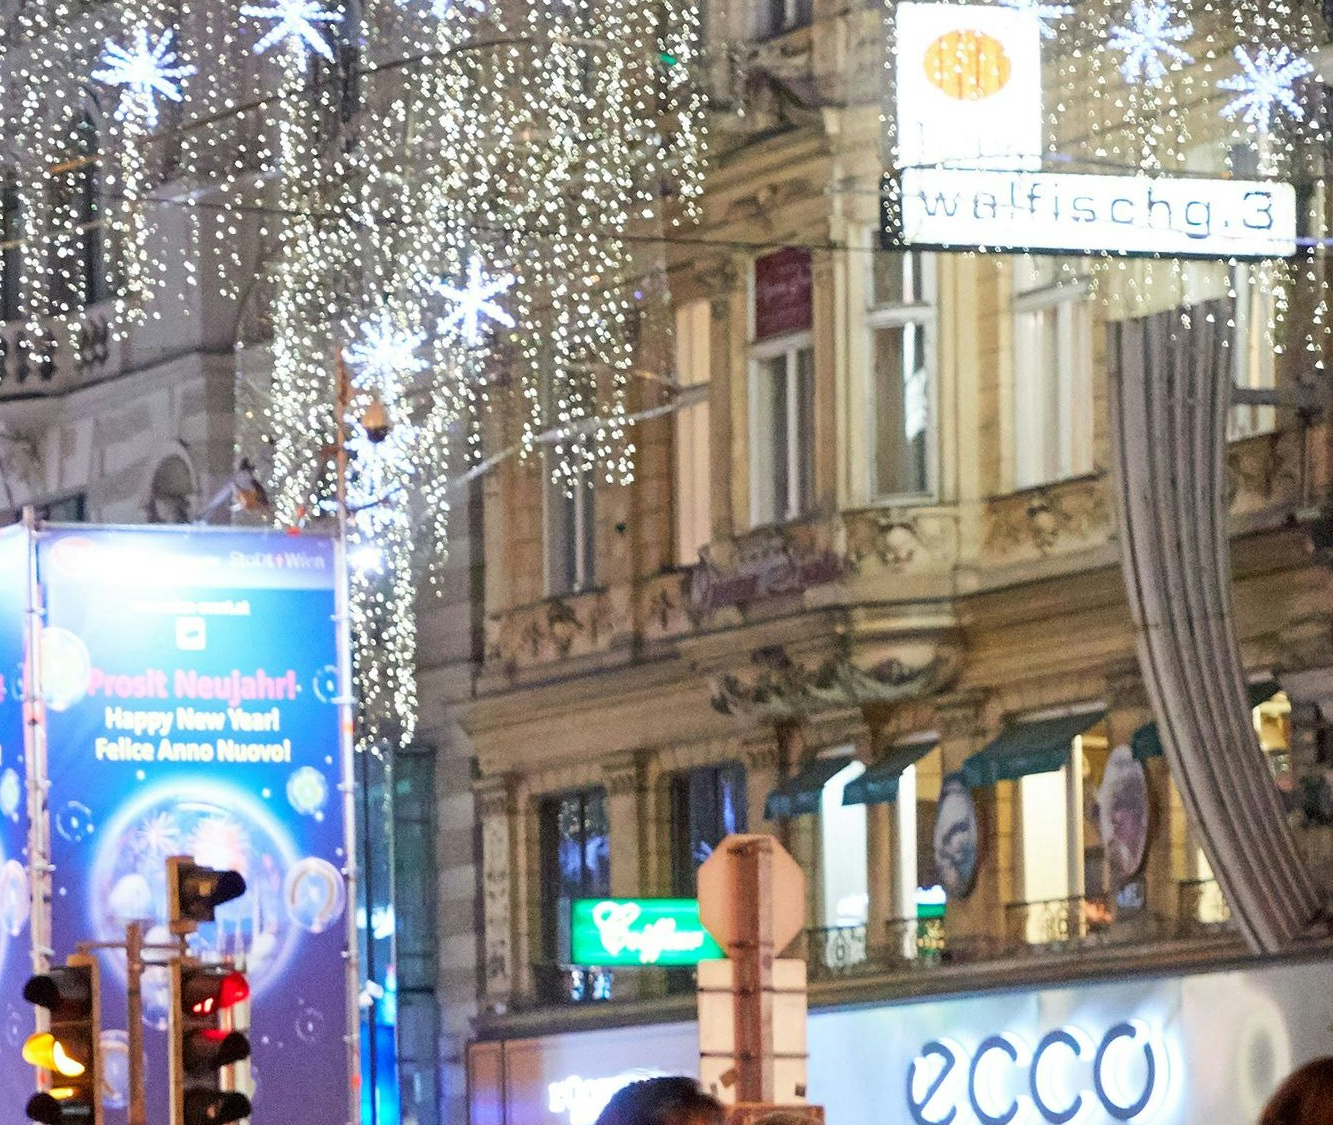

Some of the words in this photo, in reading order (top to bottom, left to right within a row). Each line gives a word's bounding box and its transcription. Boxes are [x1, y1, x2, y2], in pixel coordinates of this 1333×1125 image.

[87, 667, 168, 698] Prosit
[174, 668, 296, 707] Neujahr!
[105, 706, 173, 735] Happy
[176, 707, 226, 731] New
[227, 707, 280, 732] Year!
[95, 738, 155, 762] Felice
[157, 739, 214, 762] Anno
[217, 739, 291, 763] Nuovo!
